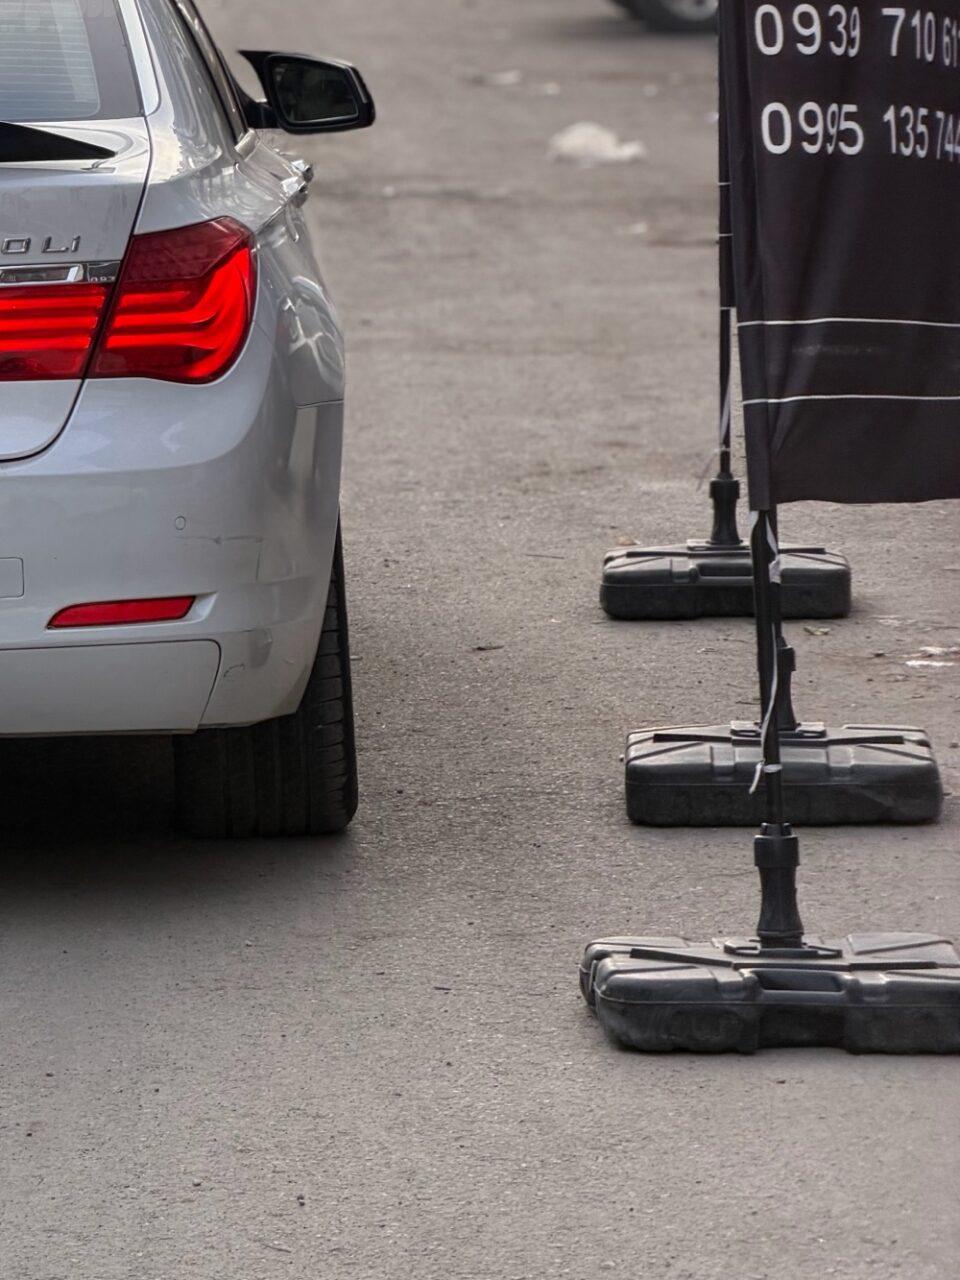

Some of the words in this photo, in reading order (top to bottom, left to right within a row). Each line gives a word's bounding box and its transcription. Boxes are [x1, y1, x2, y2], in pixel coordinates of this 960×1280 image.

[754, 3, 861, 57] 0939
[761, 101, 864, 155] 0995
[41, 234, 81, 254] Li
